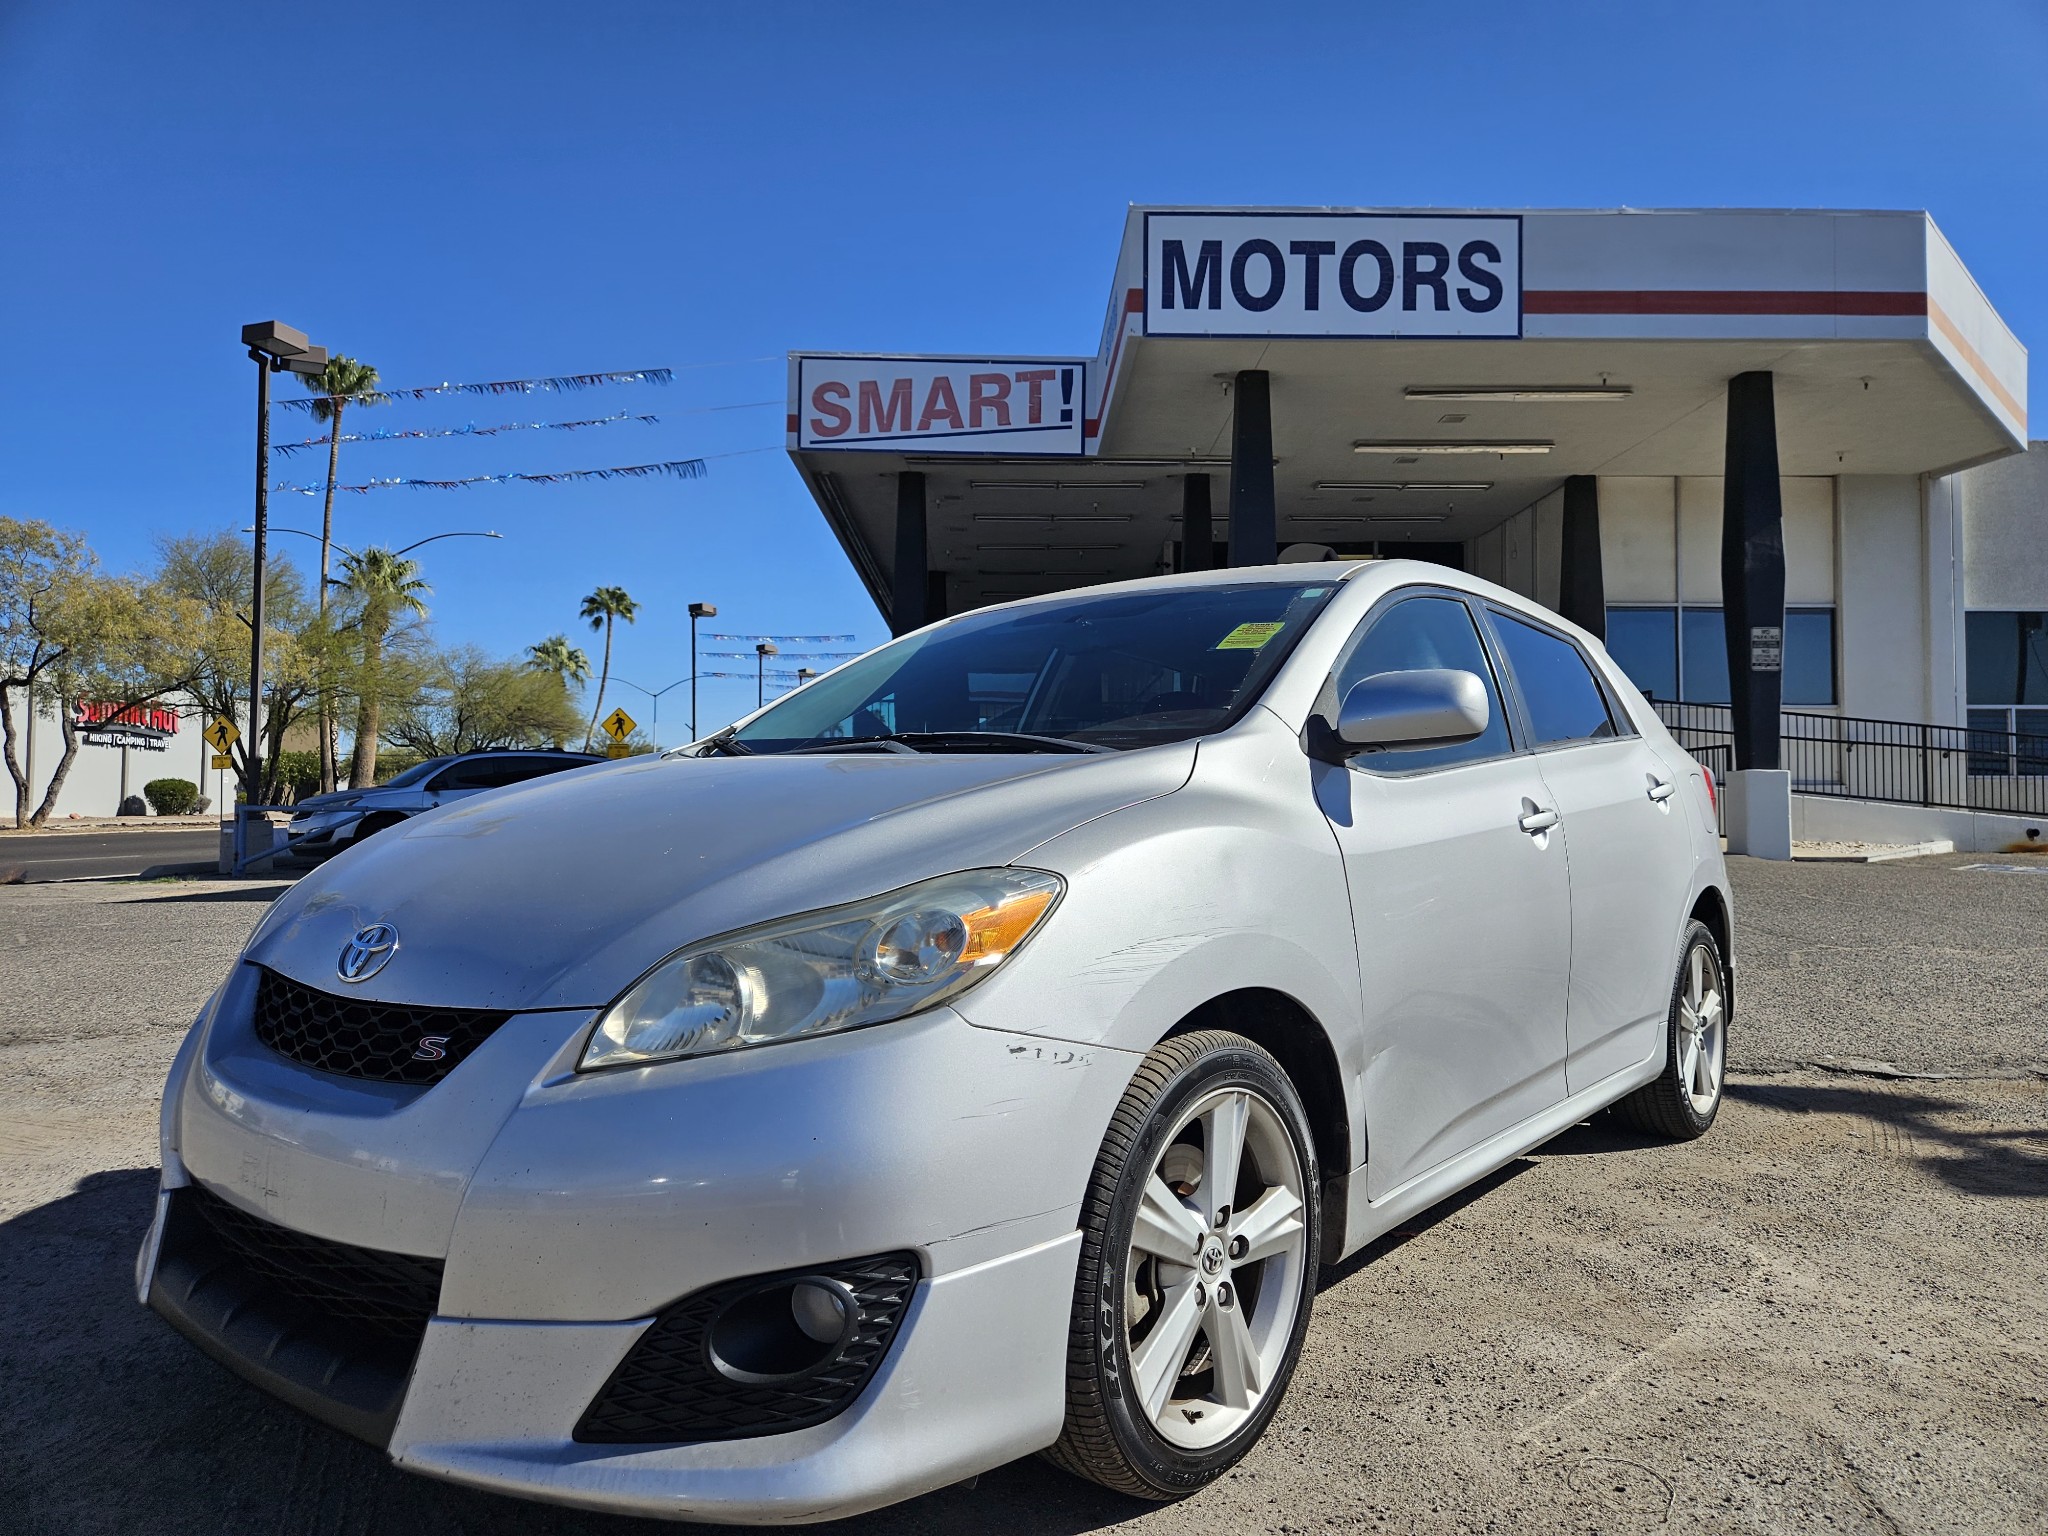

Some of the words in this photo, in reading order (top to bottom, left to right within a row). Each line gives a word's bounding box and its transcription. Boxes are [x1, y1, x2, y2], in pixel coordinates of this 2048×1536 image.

[1161, 239, 1503, 313] MOTORS
[810, 368, 1074, 437] SMART!
[89, 733, 112, 743] HIKING
[116, 735, 146, 747] CAMPING
[149, 739, 172, 749] TRAVEL
[412, 1036, 449, 1061] S
[1101, 1235, 1123, 1400] EAGLE
